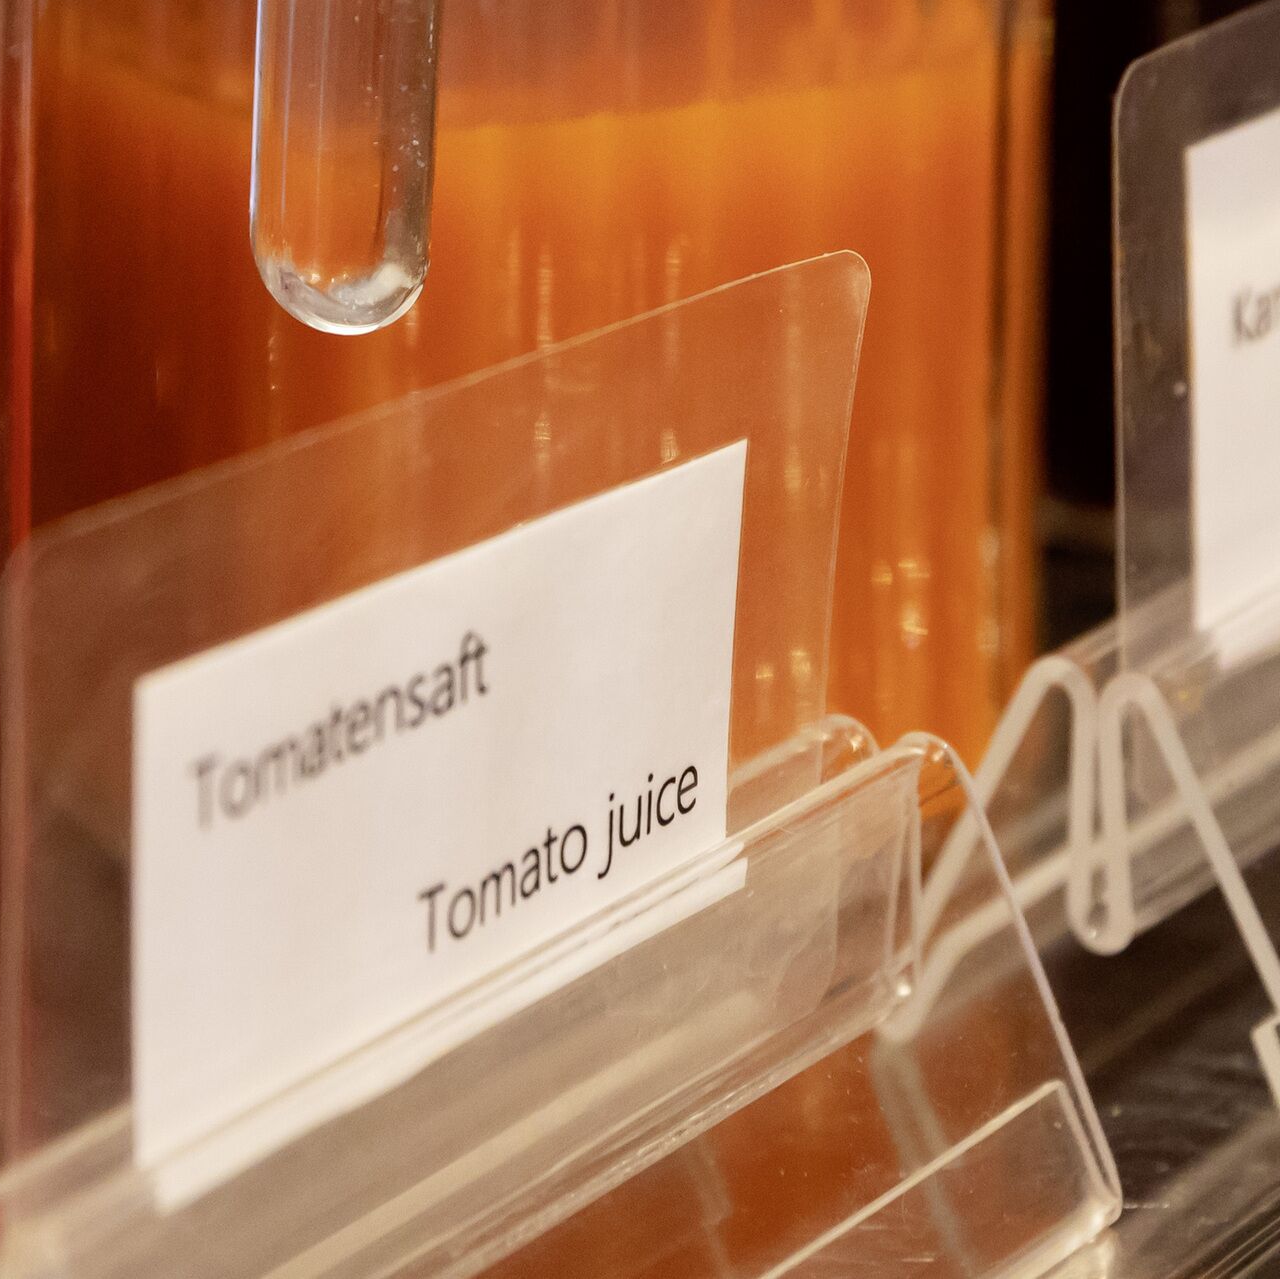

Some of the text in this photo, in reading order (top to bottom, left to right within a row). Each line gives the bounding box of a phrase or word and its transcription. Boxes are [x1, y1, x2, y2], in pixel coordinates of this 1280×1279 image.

[187, 629, 491, 828] Tomatensaft
[419, 763, 700, 954] Tomato juice
